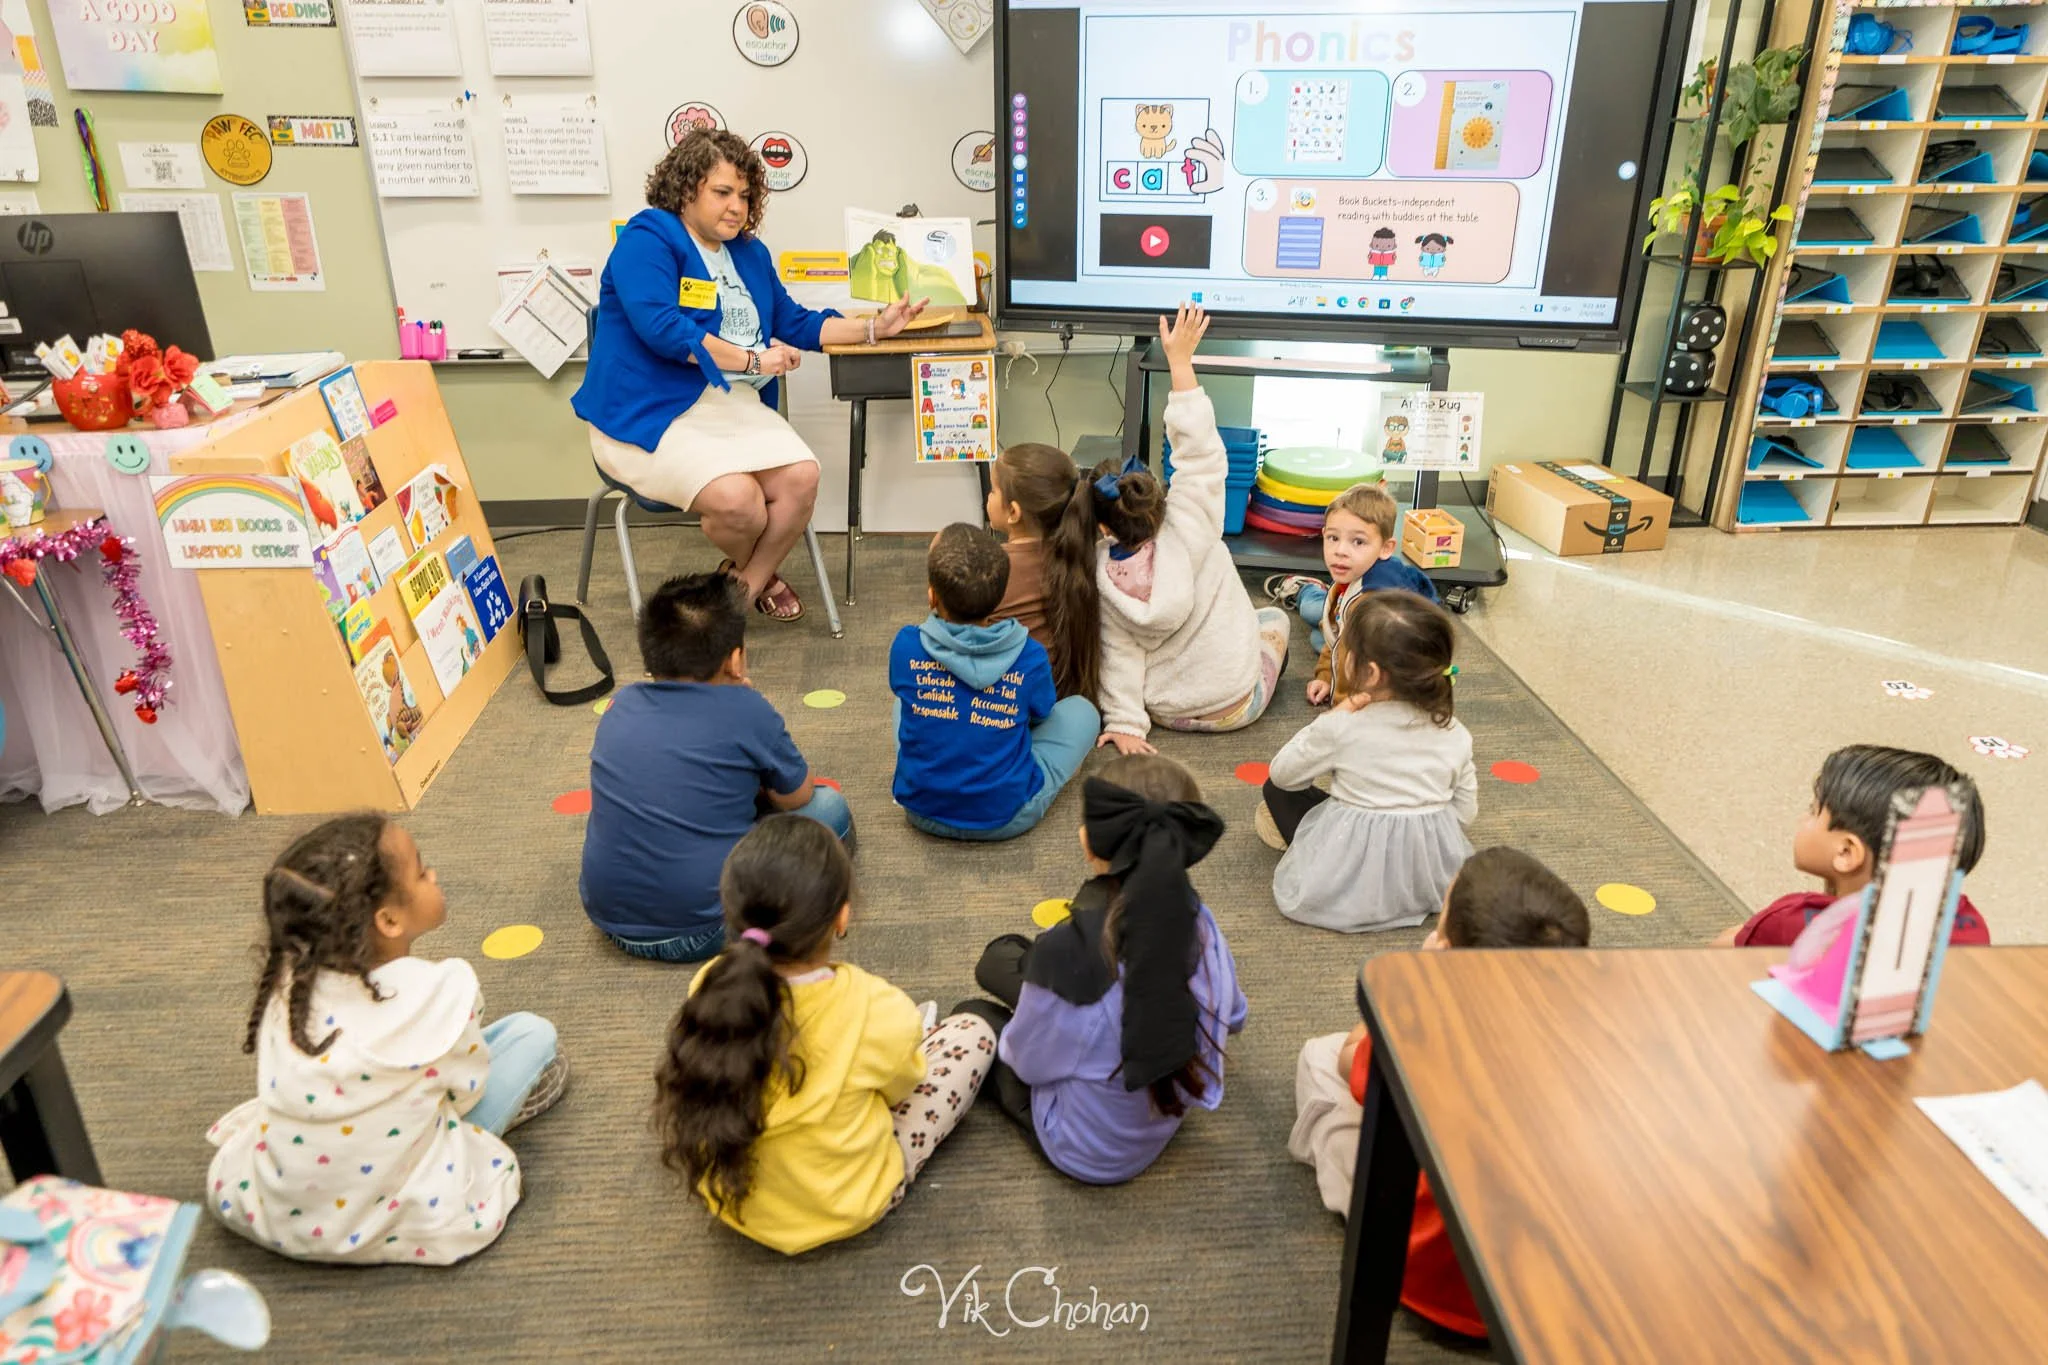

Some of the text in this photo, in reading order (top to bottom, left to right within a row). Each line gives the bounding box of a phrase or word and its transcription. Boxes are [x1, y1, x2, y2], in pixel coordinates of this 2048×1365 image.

[104, 0, 177, 24] GOOD
[270, 2, 328, 18] READING
[107, 30, 159, 53] DAY
[745, 40, 786, 50] escuchar
[1227, 20, 1416, 62] Phonics
[755, 51, 780, 62] listen
[205, 119, 232, 140] PAW
[300, 122, 346, 139] MATH
[413, 132, 452, 143] learning
[453, 133, 463, 141] to
[375, 147, 466, 156] count forward from
[377, 161, 473, 172] any given number to
[388, 175, 425, 184] number
[427, 175, 457, 184] within
[965, 168, 995, 179] escribi
[967, 179, 990, 189] write
[1338, 196, 1360, 206] Book
[1338, 212, 1479, 224] reading with buddies at the table
[1439, 399, 1461, 413] Rug
[409, 556, 444, 602] SCHOOL BUS
[430, 618, 446, 638] Went
[916, 673, 956, 688] Enfocado
[1001, 686, 1017, 699] Task
